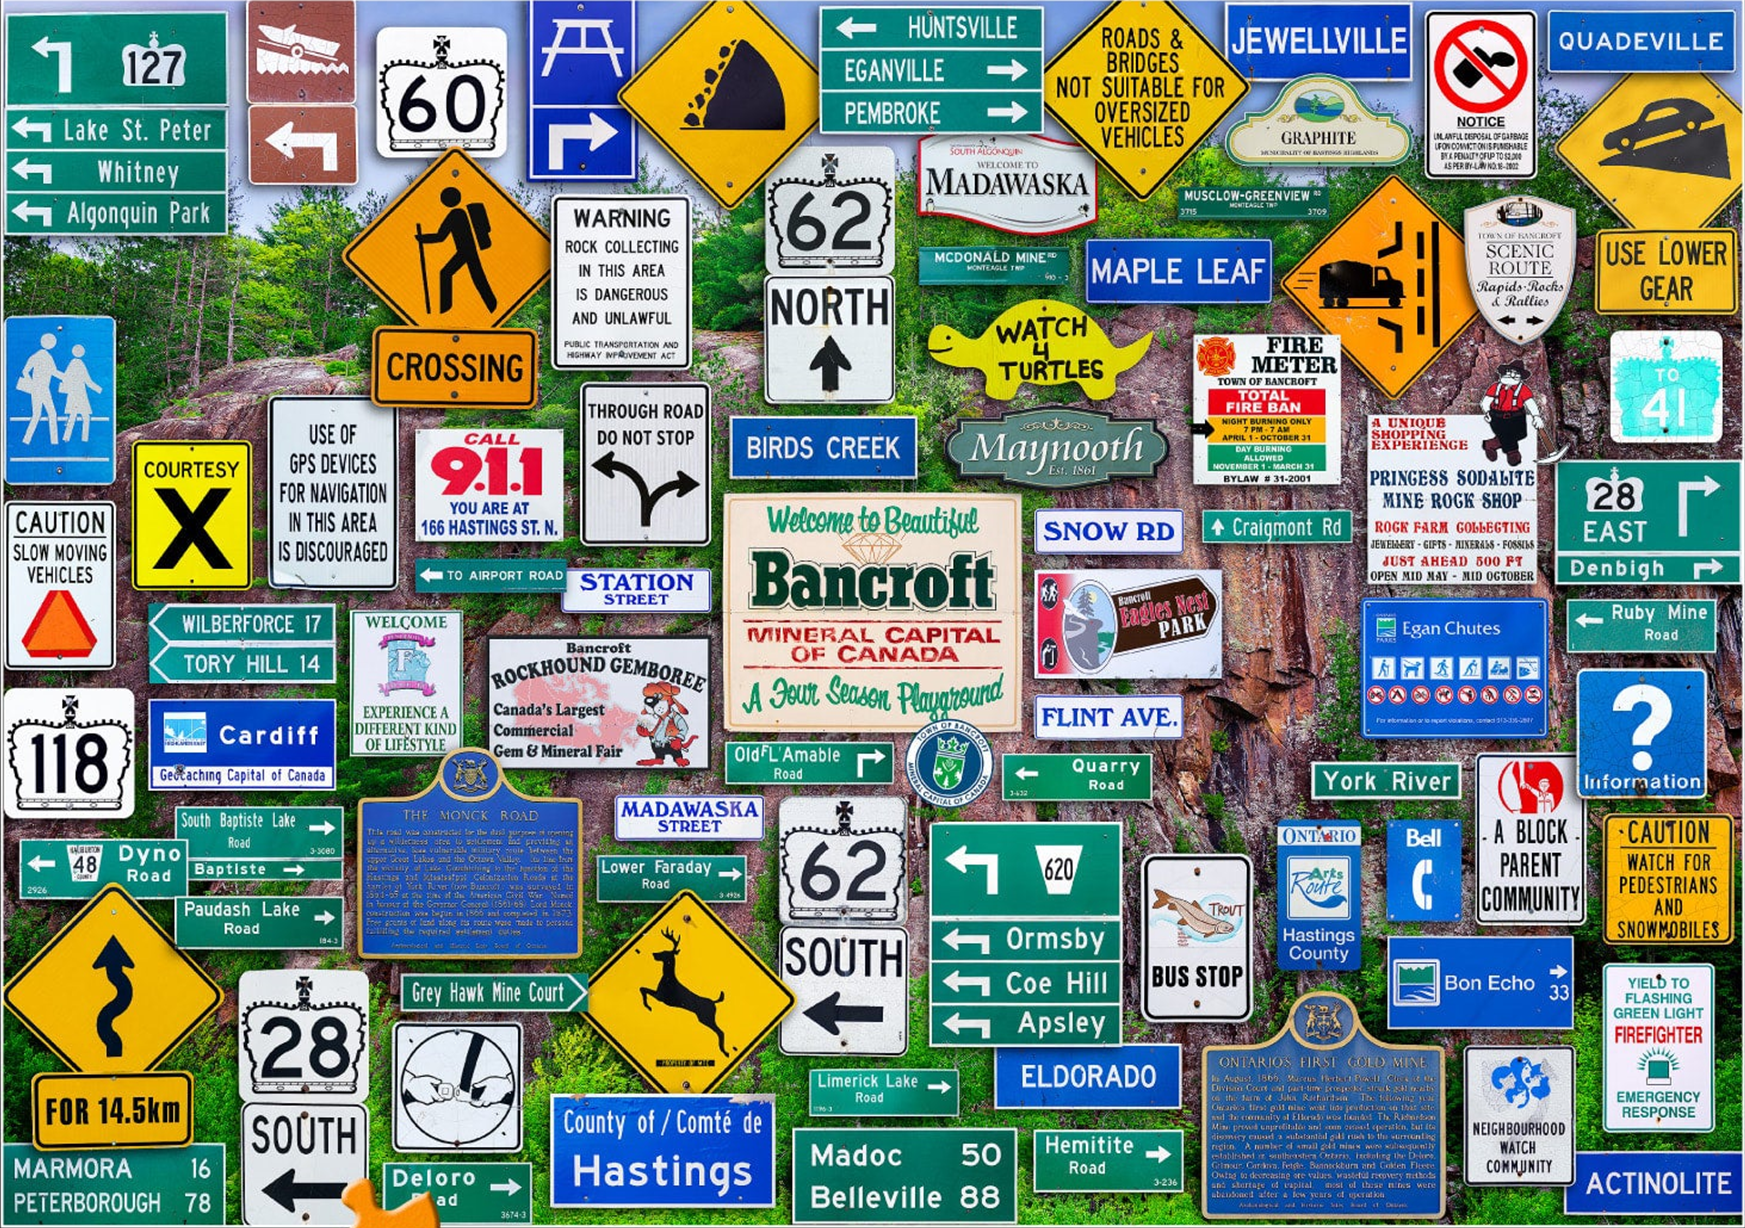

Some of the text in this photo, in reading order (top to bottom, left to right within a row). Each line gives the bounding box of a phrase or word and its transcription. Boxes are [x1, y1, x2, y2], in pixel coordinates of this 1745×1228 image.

[908, 15, 1018, 41] HUNTSVILLE
[1101, 27, 1184, 49] ROADS &
[1232, 27, 1407, 54] JEWELLVILLE
[1560, 32, 1723, 50] QUADEVILLE
[128, 51, 183, 84] 127
[846, 59, 944, 82] EGANVILLE
[1108, 52, 1179, 73] BRIDGES
[399, 74, 486, 133] 60
[844, 101, 941, 125] PEMBROKE
[65, 118, 211, 141] Lake St. Peter
[1458, 117, 1505, 128] NOTICE
[1281, 131, 1355, 144] GRAPHITE
[98, 160, 178, 188] Whitney
[926, 166, 1089, 195] MADAWASKA
[1185, 190, 1311, 203] MUSCLOW-GREENVIEW
[67, 201, 209, 228] Algonquin Park
[574, 208, 671, 227] WARNING
[787, 191, 871, 251] 62
[566, 240, 678, 253] ROCK COLLECTING
[1486, 242, 1553, 259] SCENIC
[1607, 241, 1727, 266] USE LOWER
[932, 251, 1049, 264] MCDONALD MINE
[1092, 258, 1266, 284] MAPLE LEAF
[1490, 261, 1551, 275] ROUTE
[771, 288, 888, 325] NORTH
[996, 317, 1088, 343] WATCH
[1033, 343, 1049, 360] 4
[1267, 337, 1323, 354] FIRE
[387, 352, 523, 382] CROSSING
[999, 360, 1103, 380] TURTLES
[1252, 356, 1337, 374] METER
[1655, 368, 1679, 382] TO
[1238, 389, 1289, 401] TOTAL
[588, 404, 704, 419] THROUGH ROAD
[1226, 402, 1300, 413] FIRE BAN
[1642, 388, 1685, 428] 41
[464, 433, 520, 445] CALL
[748, 436, 900, 459] BIRDS CREEK
[969, 429, 1145, 474] Maynooth
[144, 461, 239, 478] COURTESY
[290, 453, 376, 474] GPS DEVICES
[1049, 465, 1095, 475] Est. 1861
[1370, 469, 1535, 487] PRINCESS SODALITE
[1594, 483, 1635, 511] 28
[16, 511, 106, 534] CAUTION
[1044, 521, 1174, 541] SNOW RD
[1233, 518, 1342, 542] Craigmont Rd
[1584, 522, 1647, 542] EAST
[447, 570, 563, 580] TO AIRPORT ROAD
[750, 549, 996, 610] Bancroft
[1571, 560, 1664, 580] Denbigh
[580, 573, 693, 591] STATION
[604, 594, 669, 605] STREET
[366, 616, 447, 630] WELCOME
[1613, 604, 1707, 623] Ruby Mine
[183, 615, 321, 633] WILBERFORCE 17
[1403, 621, 1501, 638] Egan Chutes
[567, 643, 631, 654] Bancroft
[791, 645, 959, 663] OF CANADA
[493, 703, 606, 720] Canada's Largest
[1042, 707, 1177, 727] FLINT AVE.
[220, 725, 318, 745] Cardiff
[31, 733, 108, 794] 118
[1073, 758, 1140, 775] Quarry
[160, 768, 326, 785] Geocaching Capital of Canada
[1323, 771, 1452, 791] York River
[1584, 773, 1702, 790] Information
[621, 801, 759, 817] MADAWASKA
[1283, 828, 1356, 844] ONTARIO
[1407, 828, 1441, 847] Bell
[1495, 819, 1568, 844] A BLOCK
[1628, 820, 1709, 843] CAUTION
[73, 856, 97, 875] 48
[119, 846, 181, 866] Dyno
[1501, 853, 1561, 877] PARENT
[194, 863, 266, 877] Baptiste
[1041, 858, 1077, 884] 620
[28, 886, 47, 894] 2926
[1209, 902, 1245, 918] TROUT
[1007, 927, 1104, 955] Ormsby
[1283, 928, 1355, 945] Hastings
[1289, 945, 1349, 962] County
[1153, 966, 1243, 987] BUS STOP
[1445, 975, 1535, 991] Bon Echo
[1628, 978, 1689, 989] YIELD TO
[413, 982, 565, 1007] Grey Hawk Mine Court
[1549, 986, 1569, 1001] 33
[1018, 1011, 1105, 1039] Apsley
[1615, 1026, 1702, 1043] FIREFIGHTER
[261, 1016, 350, 1078] 28
[1300, 1056, 1336, 1068] FIRST
[1348, 1056, 1385, 1068] GOLD
[1393, 1056, 1427, 1068] MINE
[818, 1074, 918, 1087] Limerick Lake
[1022, 1065, 1156, 1088] ELDORADO
[46, 1097, 179, 1125] FOR 14.5km
[252, 1115, 356, 1154] SOUTH
[1473, 1122, 1565, 1136] NEIGHBOURHOOD
[1046, 1136, 1133, 1153] Hemitite
[812, 1143, 1001, 1166] Madoc 50
[15, 1158, 211, 1178] MARMORA 16
[574, 1154, 752, 1199] Hastings
[393, 1169, 475, 1187] Deloro
[1586, 1172, 1732, 1195] ACTINOLITE
